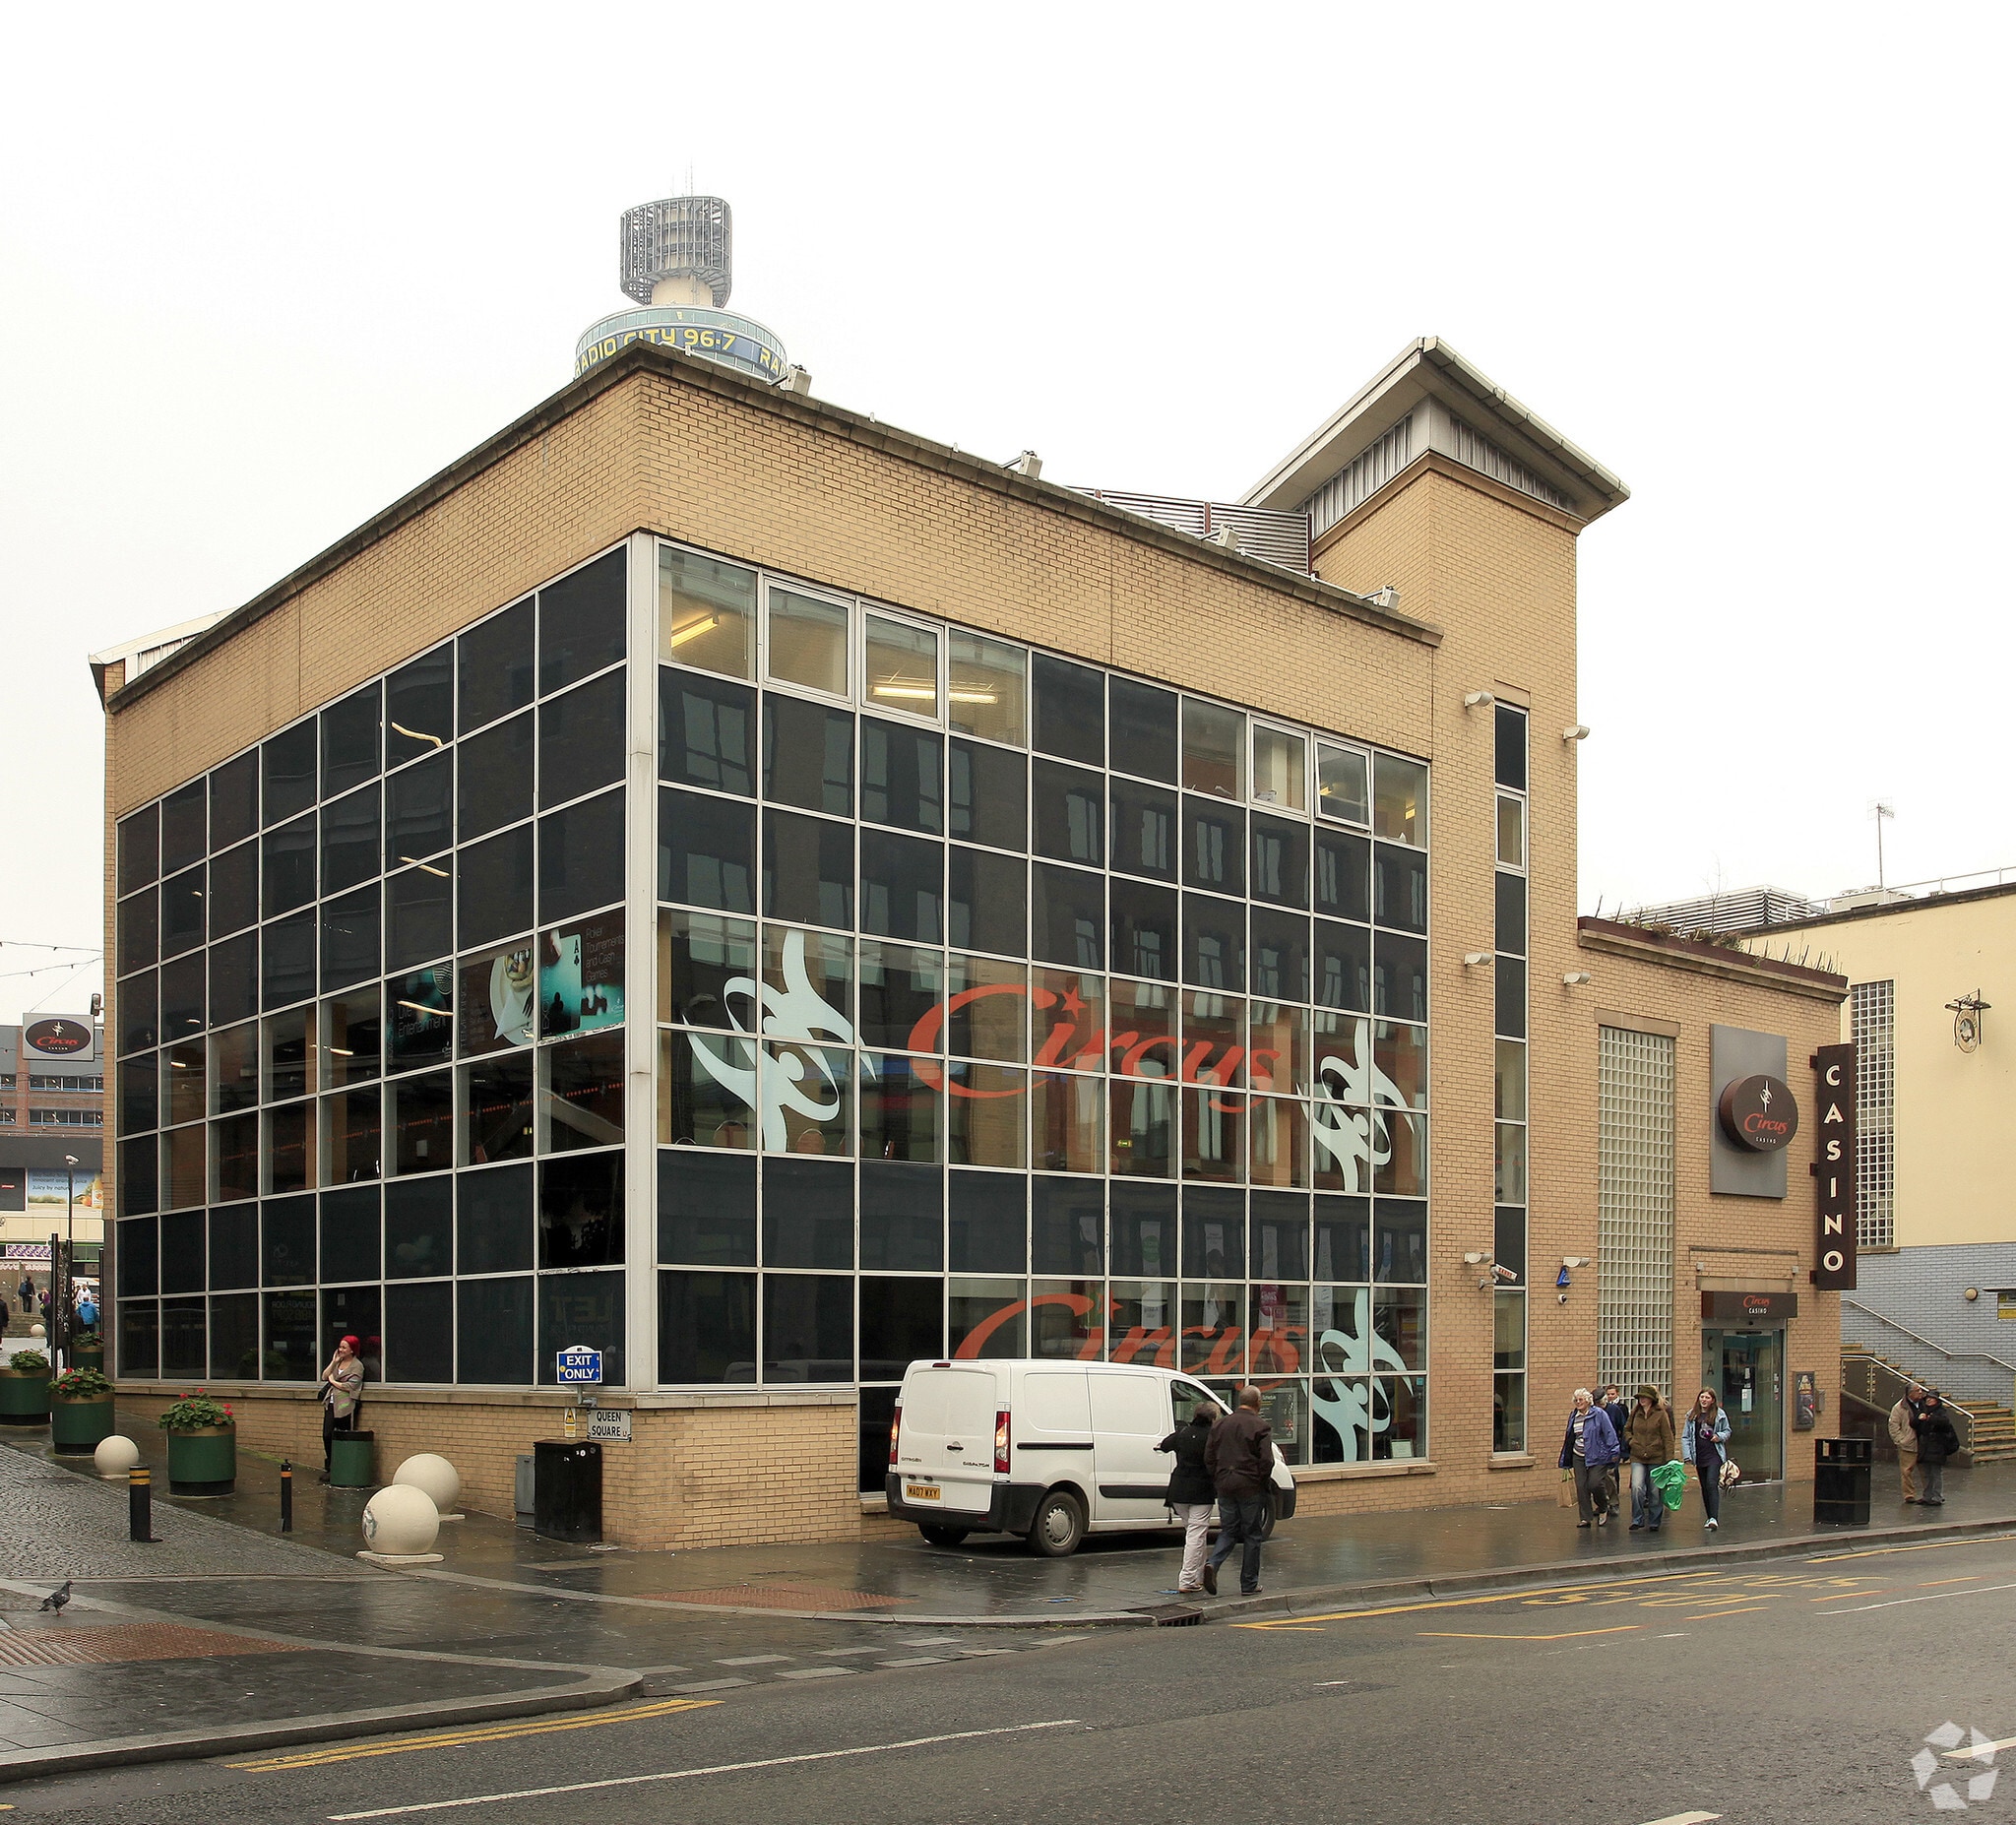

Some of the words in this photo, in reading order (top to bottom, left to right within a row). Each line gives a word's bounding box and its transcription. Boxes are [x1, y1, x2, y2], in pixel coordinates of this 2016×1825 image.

[575, 338, 616, 378] RADIO
[574, 939, 580, 954] A
[586, 934, 624, 953] Tournaments
[586, 957, 598, 969] and
[598, 952, 615, 965] Cash
[586, 969, 607, 982] Games
[908, 984, 1280, 1112] Circus
[1744, 1112, 1789, 1134] Circus
[1823, 1064, 1844, 1272] CASINO
[1742, 1294, 1770, 1308] Circus
[566, 1354, 593, 1366] EXIT
[564, 1368, 596, 1379] ONLY
[597, 1411, 621, 1421] QUEEN
[592, 1425, 620, 1436] SQUARE
